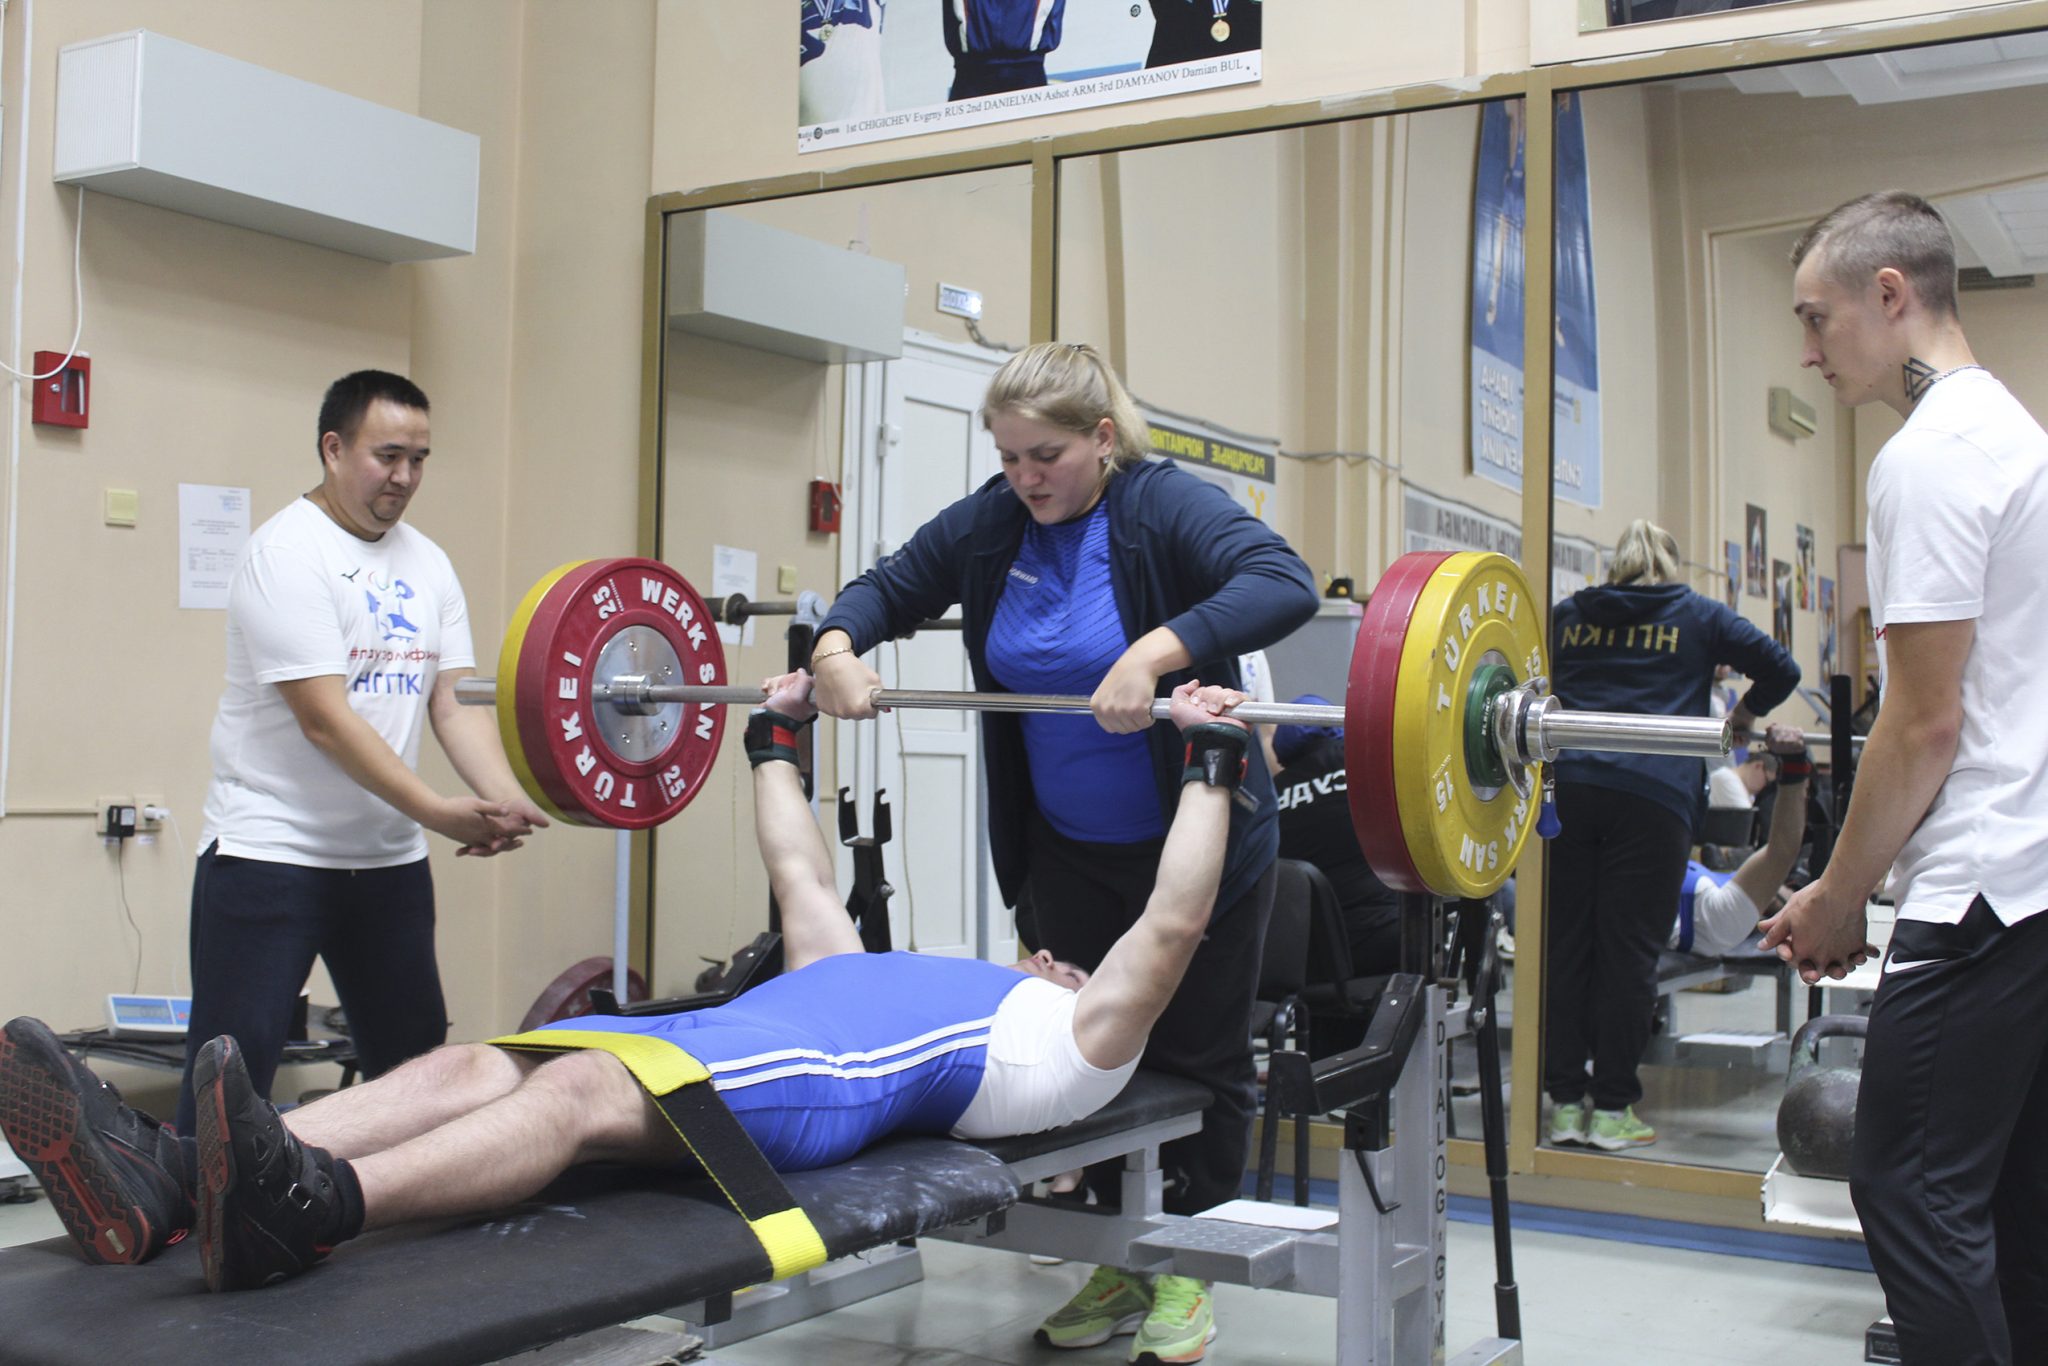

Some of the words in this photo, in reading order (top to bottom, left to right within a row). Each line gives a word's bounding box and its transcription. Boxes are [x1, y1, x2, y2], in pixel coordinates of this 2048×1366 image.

[846, 123, 857, 134] 1st
[858, 113, 912, 131] CHIGICHEV
[944, 104, 964, 118] RUS
[966, 102, 982, 114] 2nd
[983, 92, 1042, 111] DANIELYAN
[1044, 88, 1070, 101] Ashot
[1072, 84, 1096, 97] ARM
[1098, 80, 1113, 92] 3rd
[1115, 69, 1180, 89] DAMYANOV
[1181, 63, 1218, 78] Damian
[1220, 59, 1243, 72] BUL
[592, 585, 617, 620] 25
[641, 577, 707, 651] WERK
[695, 662, 716, 740] SN
[1437, 581, 1518, 714] TÜRKEI
[559, 651, 636, 808] TÜRKEI
[664, 764, 686, 798] 25
[1435, 771, 1454, 813] 15
[1460, 833, 1498, 873] SAN
